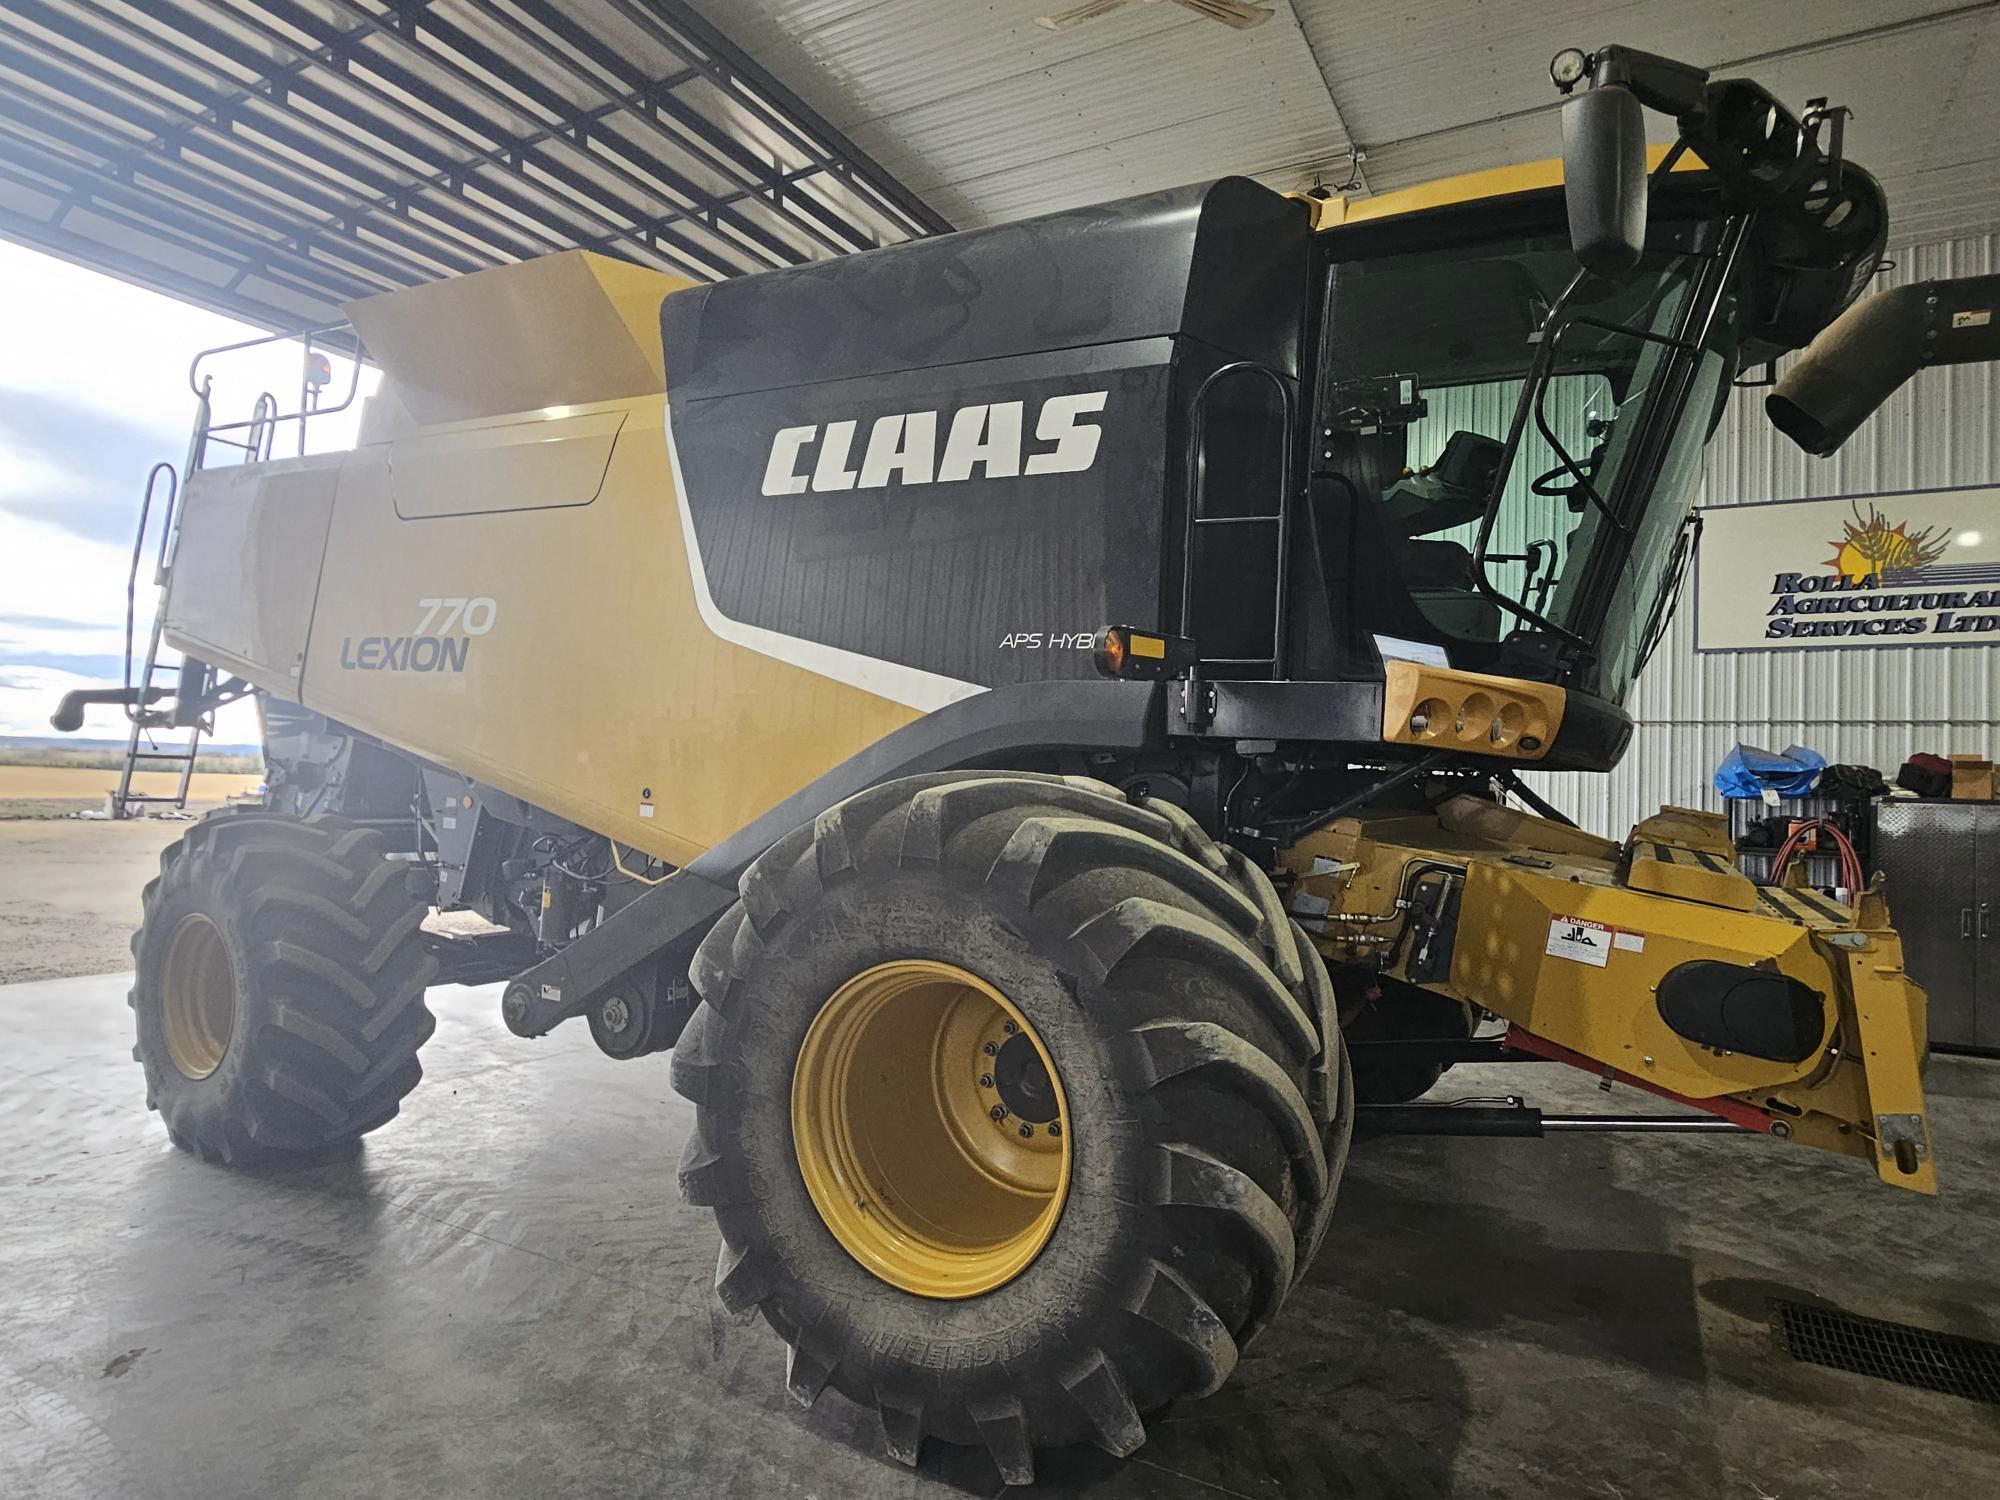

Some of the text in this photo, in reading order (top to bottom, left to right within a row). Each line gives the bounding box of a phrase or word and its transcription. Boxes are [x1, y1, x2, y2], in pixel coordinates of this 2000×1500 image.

[762, 391, 1107, 496] CLAAS
[1771, 572, 1880, 594] ROLLA
[414, 597, 497, 636] 770
[1765, 617, 1927, 638] SERVICES
[999, 633, 1097, 649] APS HYB
[341, 637, 470, 672] LEXION
[1570, 917, 1605, 931] DANGER
